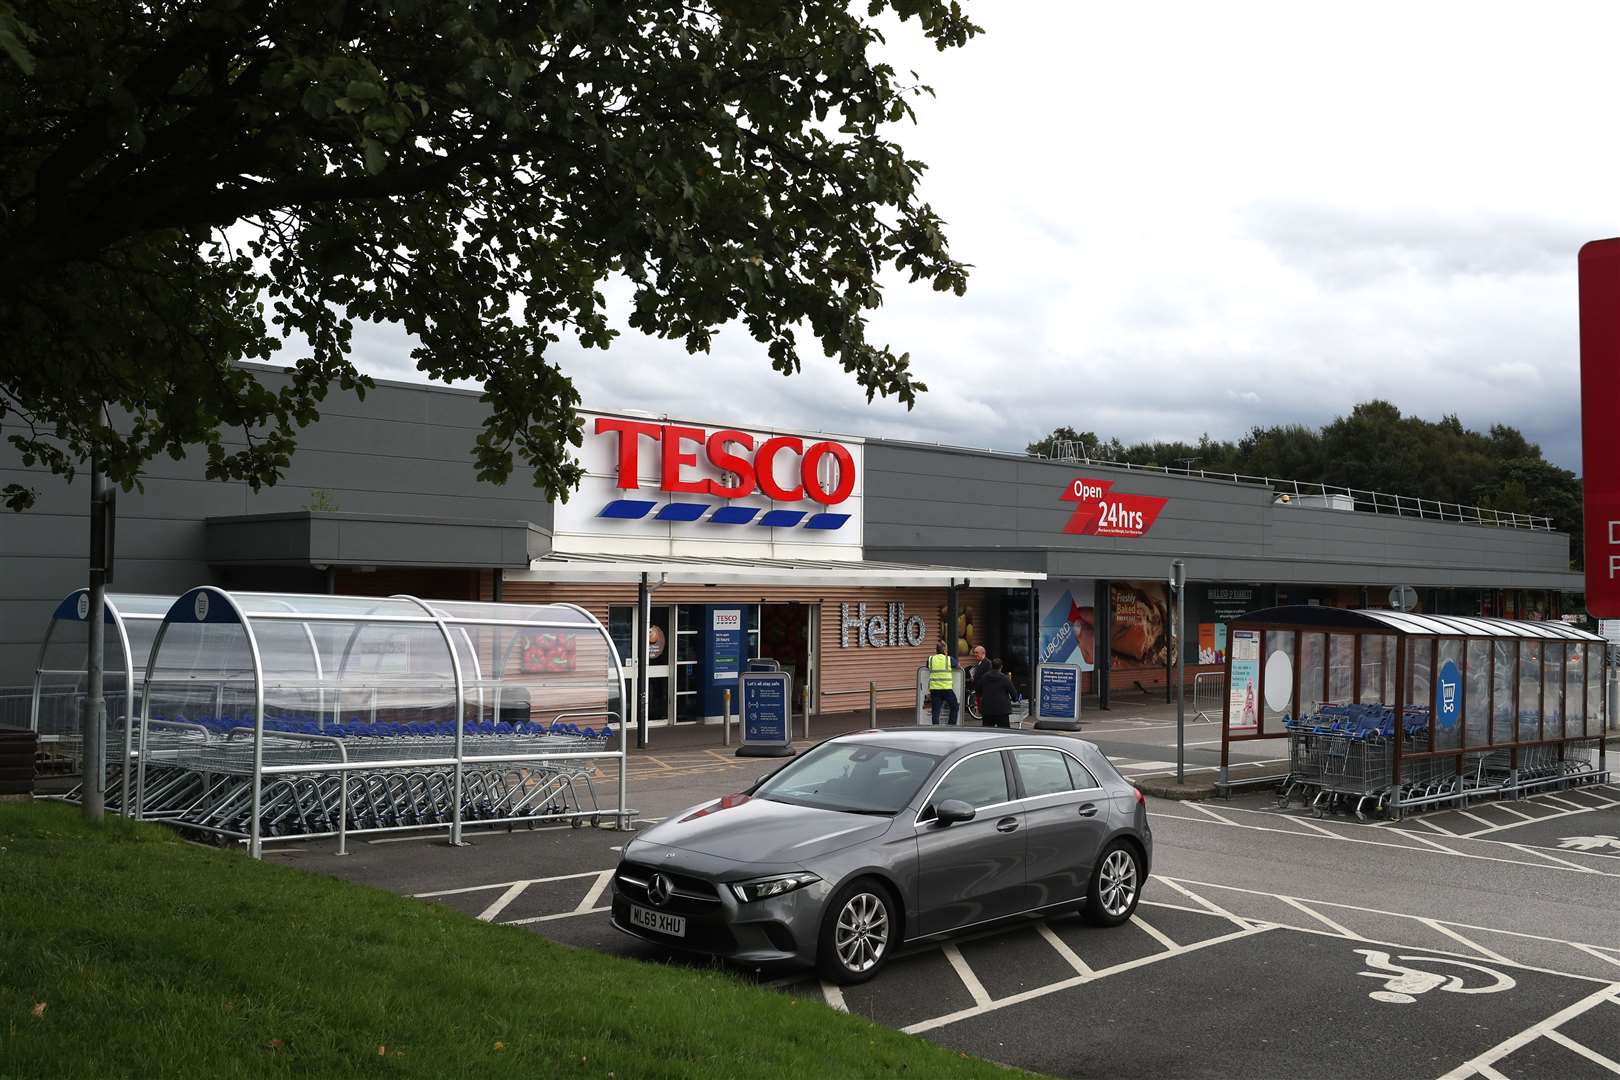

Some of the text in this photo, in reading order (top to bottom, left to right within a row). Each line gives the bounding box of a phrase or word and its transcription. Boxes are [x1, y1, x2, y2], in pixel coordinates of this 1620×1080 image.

[594, 418, 856, 505] TESCO
[1074, 480, 1102, 500] Open
[1098, 501, 1143, 530] 24hrs
[841, 601, 927, 648] Hello
[634, 908, 681, 932] ML69 XHU
